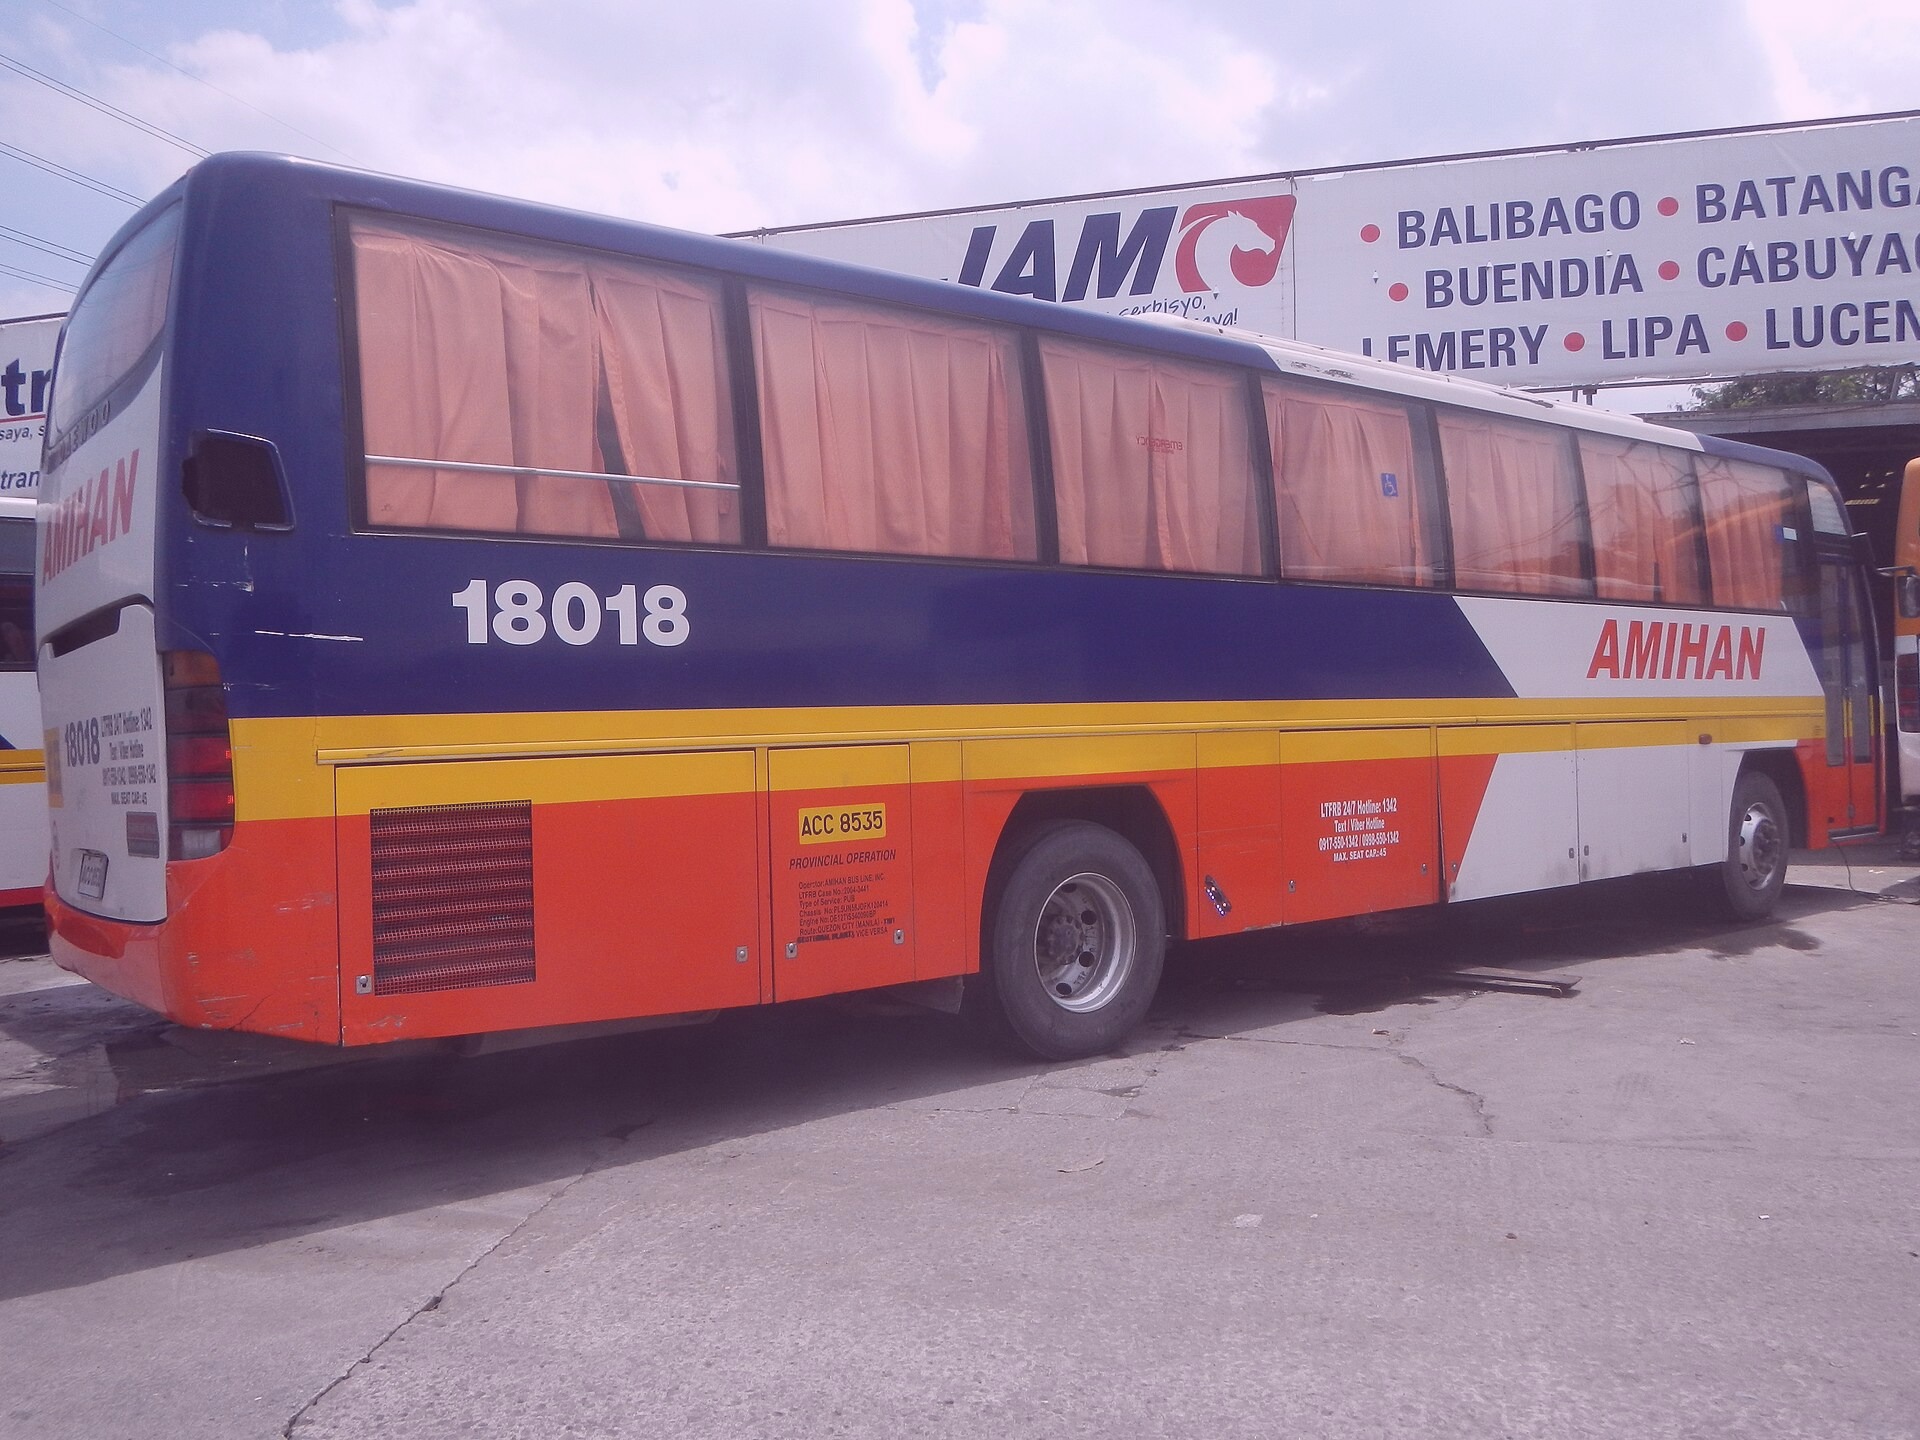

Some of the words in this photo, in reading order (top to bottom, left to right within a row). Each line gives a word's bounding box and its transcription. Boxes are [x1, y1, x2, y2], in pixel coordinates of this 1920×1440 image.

[1398, 190, 1640, 249] BALIBAGO
[1696, 166, 1920, 223] BATANG
[1425, 253, 1643, 308] BUENDIA
[1697, 233, 1920, 287] CABUYA
[1602, 314, 1710, 359] LIPA
[42, 449, 140, 586] AMIHAN
[452, 579, 690, 647] 18018
[1587, 619, 1765, 680] AMIHAN
[65, 717, 100, 767] 18018
[801, 815, 834, 836] ACC
[840, 810, 883, 833] 8535
[1320, 802, 1341, 817] LTFRB
[1343, 801, 1356, 816] 24/7
[1382, 798, 1397, 812] 1342
[789, 854, 843, 870] PROVINCIAL
[846, 849, 896, 863] OPERATION
[1349, 850, 1364, 860] SEAT
